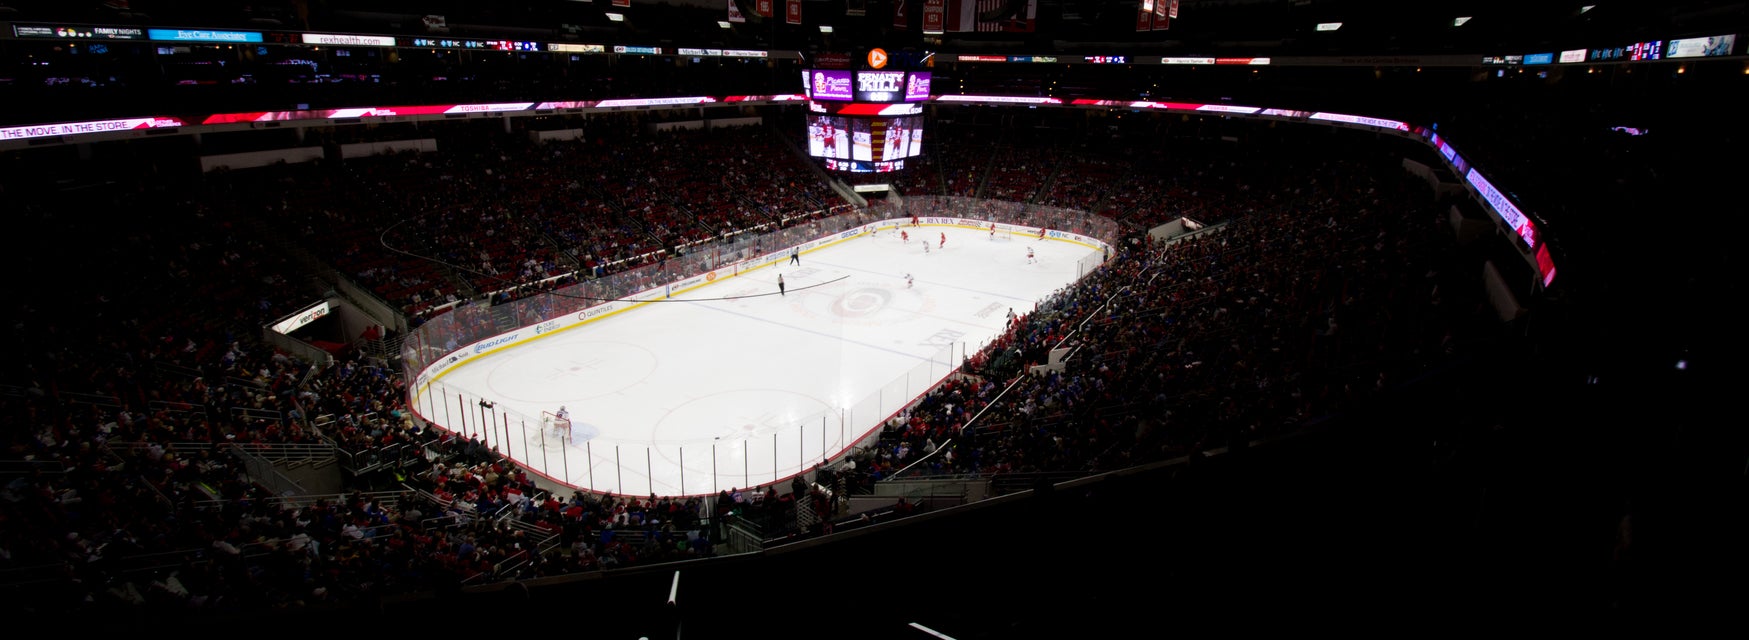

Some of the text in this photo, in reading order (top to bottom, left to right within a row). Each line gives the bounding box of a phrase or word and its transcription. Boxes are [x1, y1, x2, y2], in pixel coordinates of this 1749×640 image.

[94, 27, 141, 36] FAMILY NIGHTS
[320, 36, 380, 45] rexhealth.com
[858, 72, 904, 82] PENALTY
[859, 80, 899, 92] KILL
[2, 129, 23, 139] THE
[63, 125, 72, 133] IN
[75, 123, 95, 133] THE
[841, 229, 859, 239] GEICO
[301, 308, 325, 324] verizon
[587, 305, 613, 318] QUINTILES
[477, 334, 518, 352] BUD LIGHT
[431, 360, 449, 374] Michael
